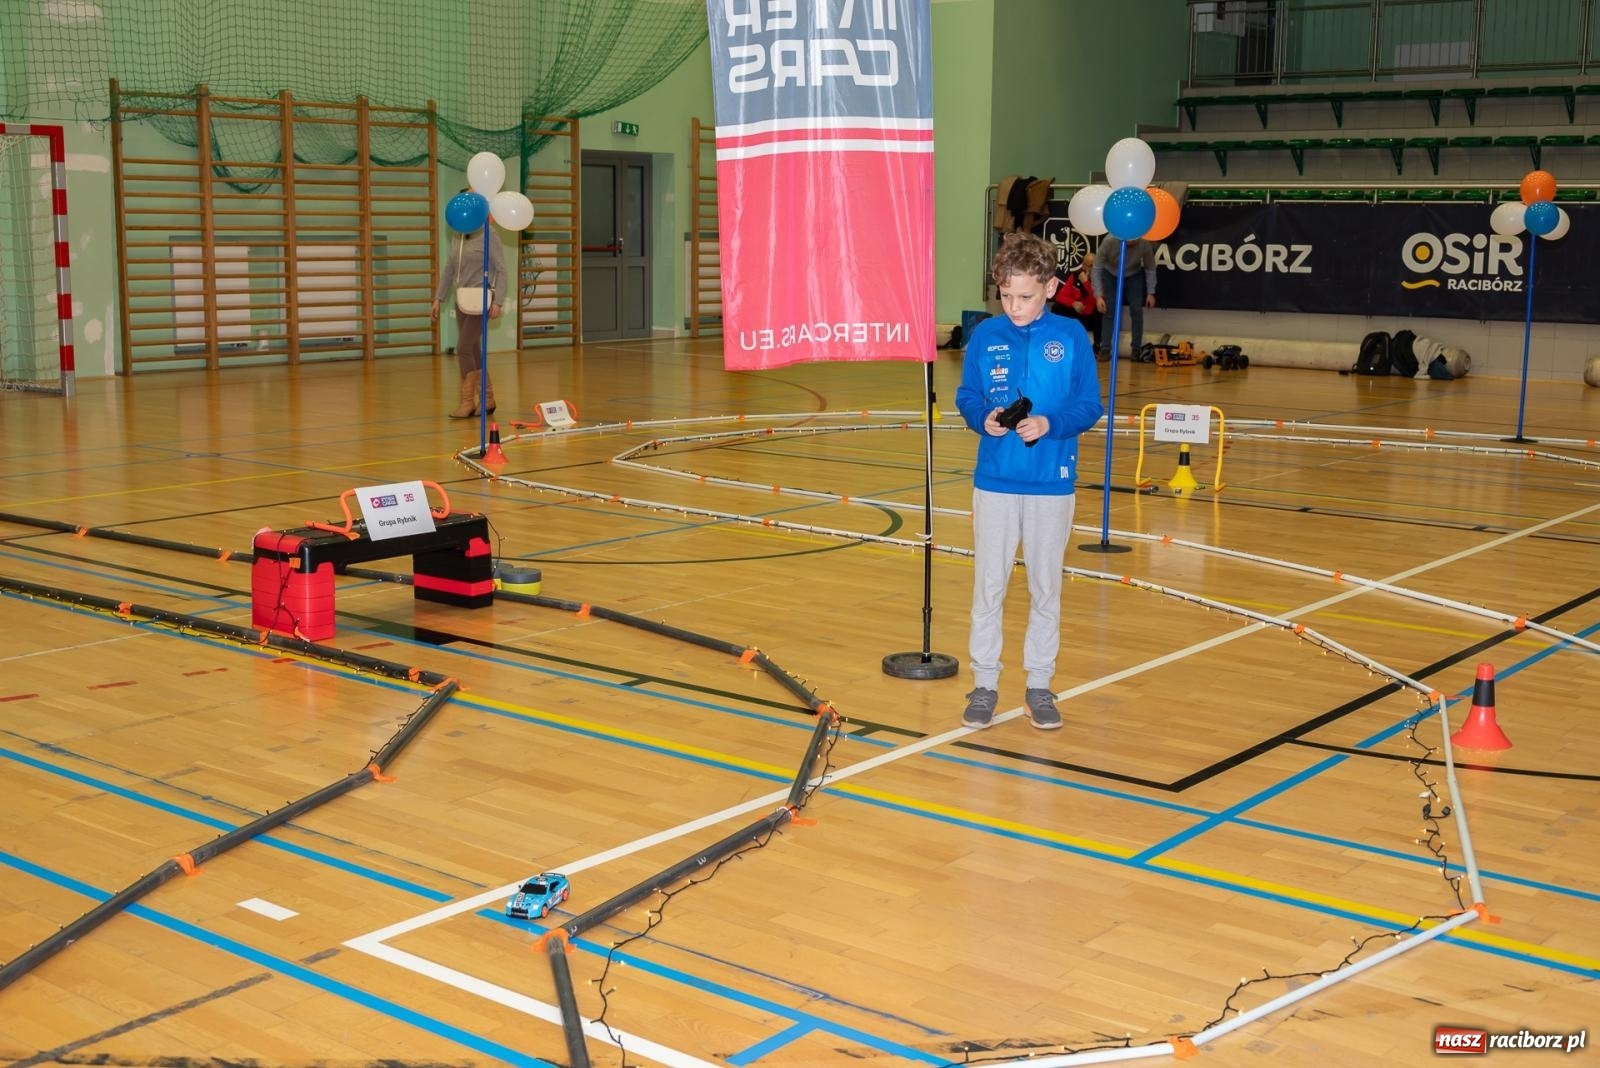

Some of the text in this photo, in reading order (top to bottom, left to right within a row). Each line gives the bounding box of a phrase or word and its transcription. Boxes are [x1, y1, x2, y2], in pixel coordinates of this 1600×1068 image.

[1154, 233, 1312, 274] ACIBÓRZ
[1447, 276, 1523, 292] RACIBÓRZ
[403, 493, 415, 502] 35
[378, 515, 417, 527] Grupa Rybnik
